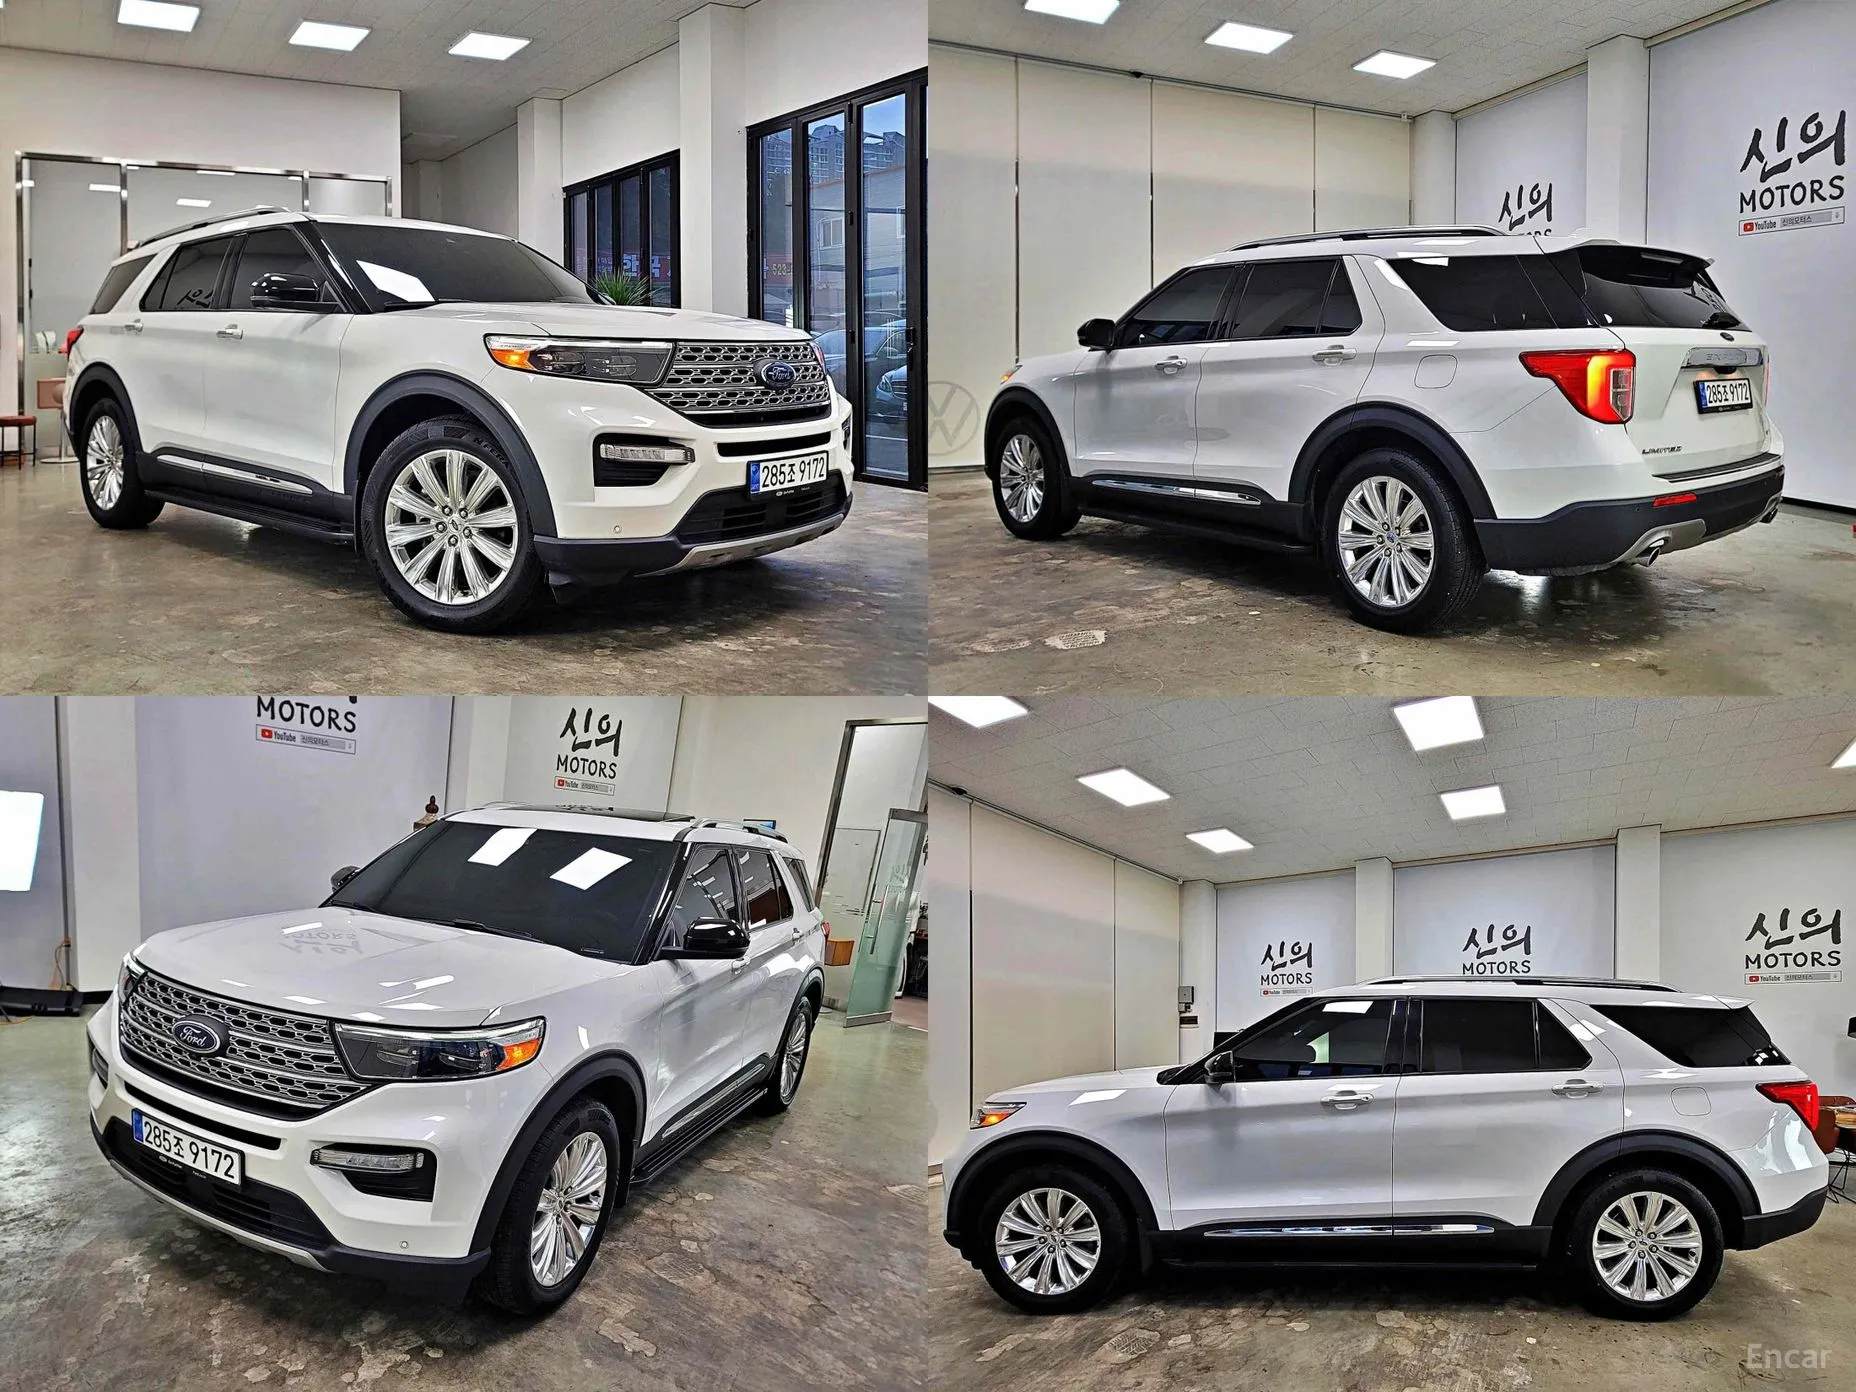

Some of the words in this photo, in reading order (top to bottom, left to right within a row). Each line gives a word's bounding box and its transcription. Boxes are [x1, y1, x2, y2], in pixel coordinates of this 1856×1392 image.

[1740, 110, 1846, 183] 신의
[1498, 183, 1552, 231] 신의
[1740, 175, 1845, 213] MOTORS
[1755, 220, 1777, 231] YouTube
[768, 366, 791, 380] Ford
[1706, 384, 1729, 403] 285조
[1729, 382, 1749, 401] 9172
[761, 463, 796, 488] 285조
[799, 456, 825, 482] 9172
[257, 695, 357, 733] MOTORS
[560, 707, 623, 757] 신의
[556, 753, 617, 780] MOTORS
[1462, 924, 1531, 960] 신의
[1744, 908, 1842, 950] 신의
[1260, 940, 1313, 972] 신의
[1462, 960, 1531, 975] MOTORS
[1745, 950, 1842, 970] MOTORS
[1260, 972, 1313, 986] MOTORS
[179, 1025, 206, 1047] Ford
[144, 1121, 185, 1159] 285조
[189, 1141, 235, 1179] 9172
